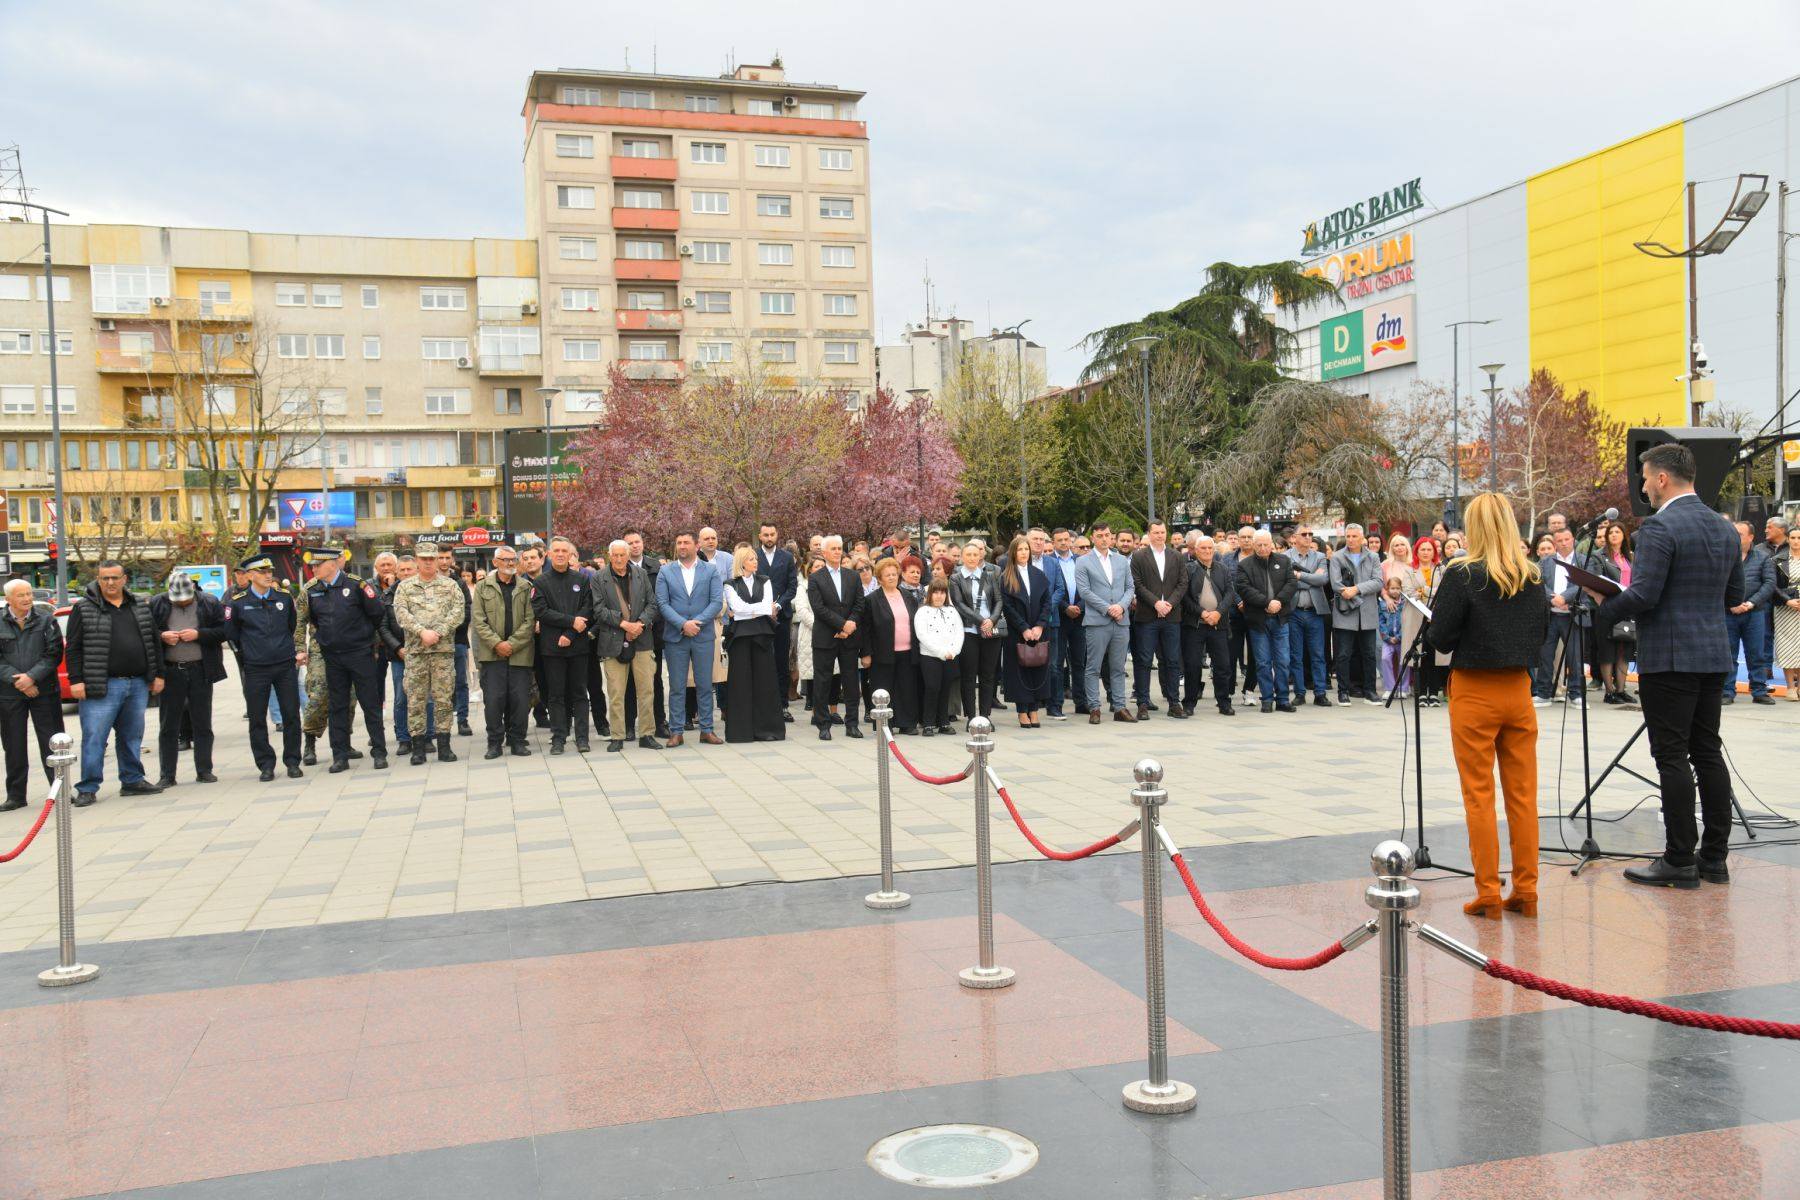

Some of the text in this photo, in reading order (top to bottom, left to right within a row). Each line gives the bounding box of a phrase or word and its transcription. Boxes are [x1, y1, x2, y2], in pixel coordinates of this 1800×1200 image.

[1321, 177, 1423, 243] ATOS BANK
[1375, 266, 1414, 291] CENTAR
[1333, 325, 1350, 353] D
[1376, 312, 1402, 341] dm
[1324, 354, 1362, 371] DEICHMANN
[268, 534, 293, 544] betting
[417, 534, 436, 543] fast
[436, 533, 459, 543] food
